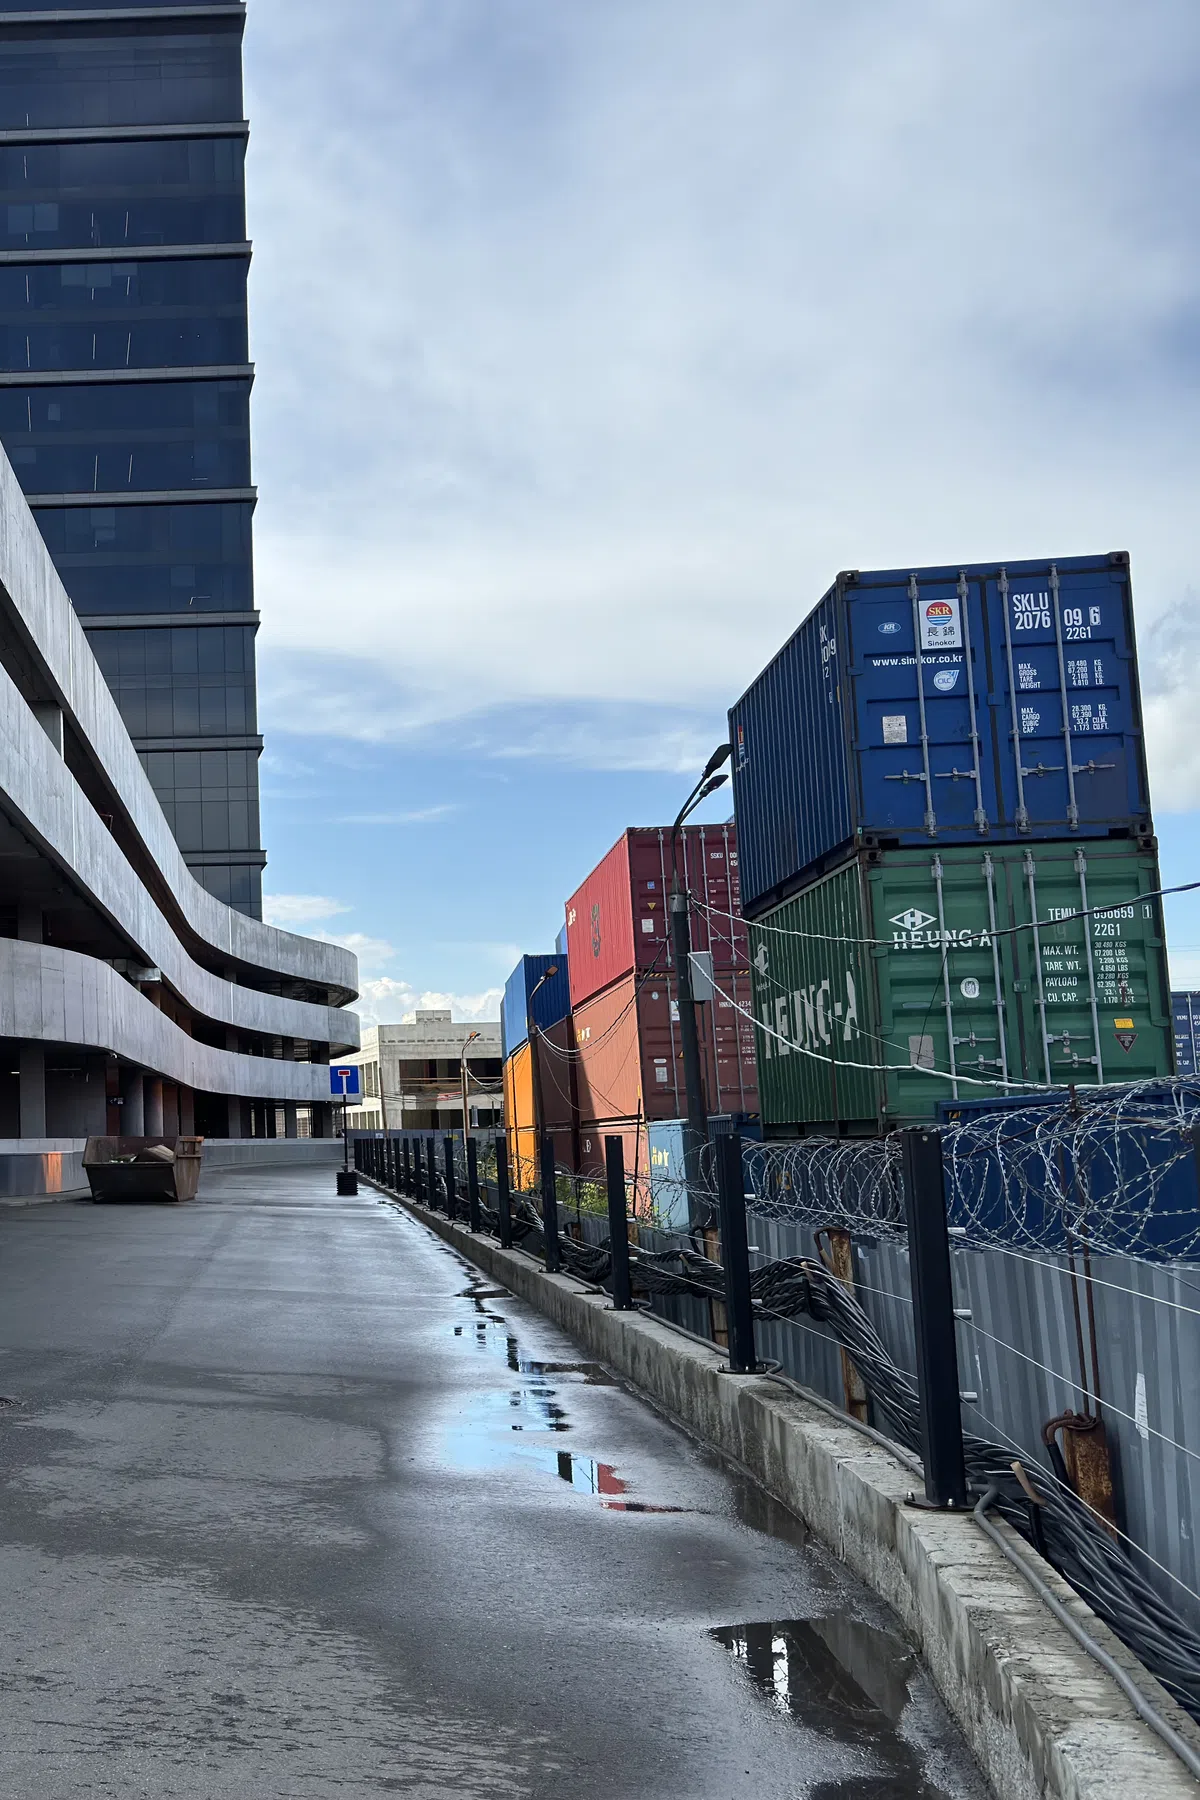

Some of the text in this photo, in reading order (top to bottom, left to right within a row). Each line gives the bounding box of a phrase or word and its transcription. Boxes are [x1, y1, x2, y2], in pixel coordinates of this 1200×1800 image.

[1012, 592, 1049, 612] SKLU
[928, 605, 951, 616] SKR
[1014, 606, 1101, 630] 2076 09 6
[1065, 626, 1092, 640] 22G1
[1048, 907, 1076, 921] TEMU
[1094, 923, 1120, 936] 22G1
[892, 929, 992, 949] HEUNG-A
[1043, 945, 1079, 956] MAX. WT.
[1044, 960, 1082, 971] TARE WT.
[1045, 977, 1078, 987] PAYLOAD
[1047, 992, 1079, 1003] CU. CAP.
